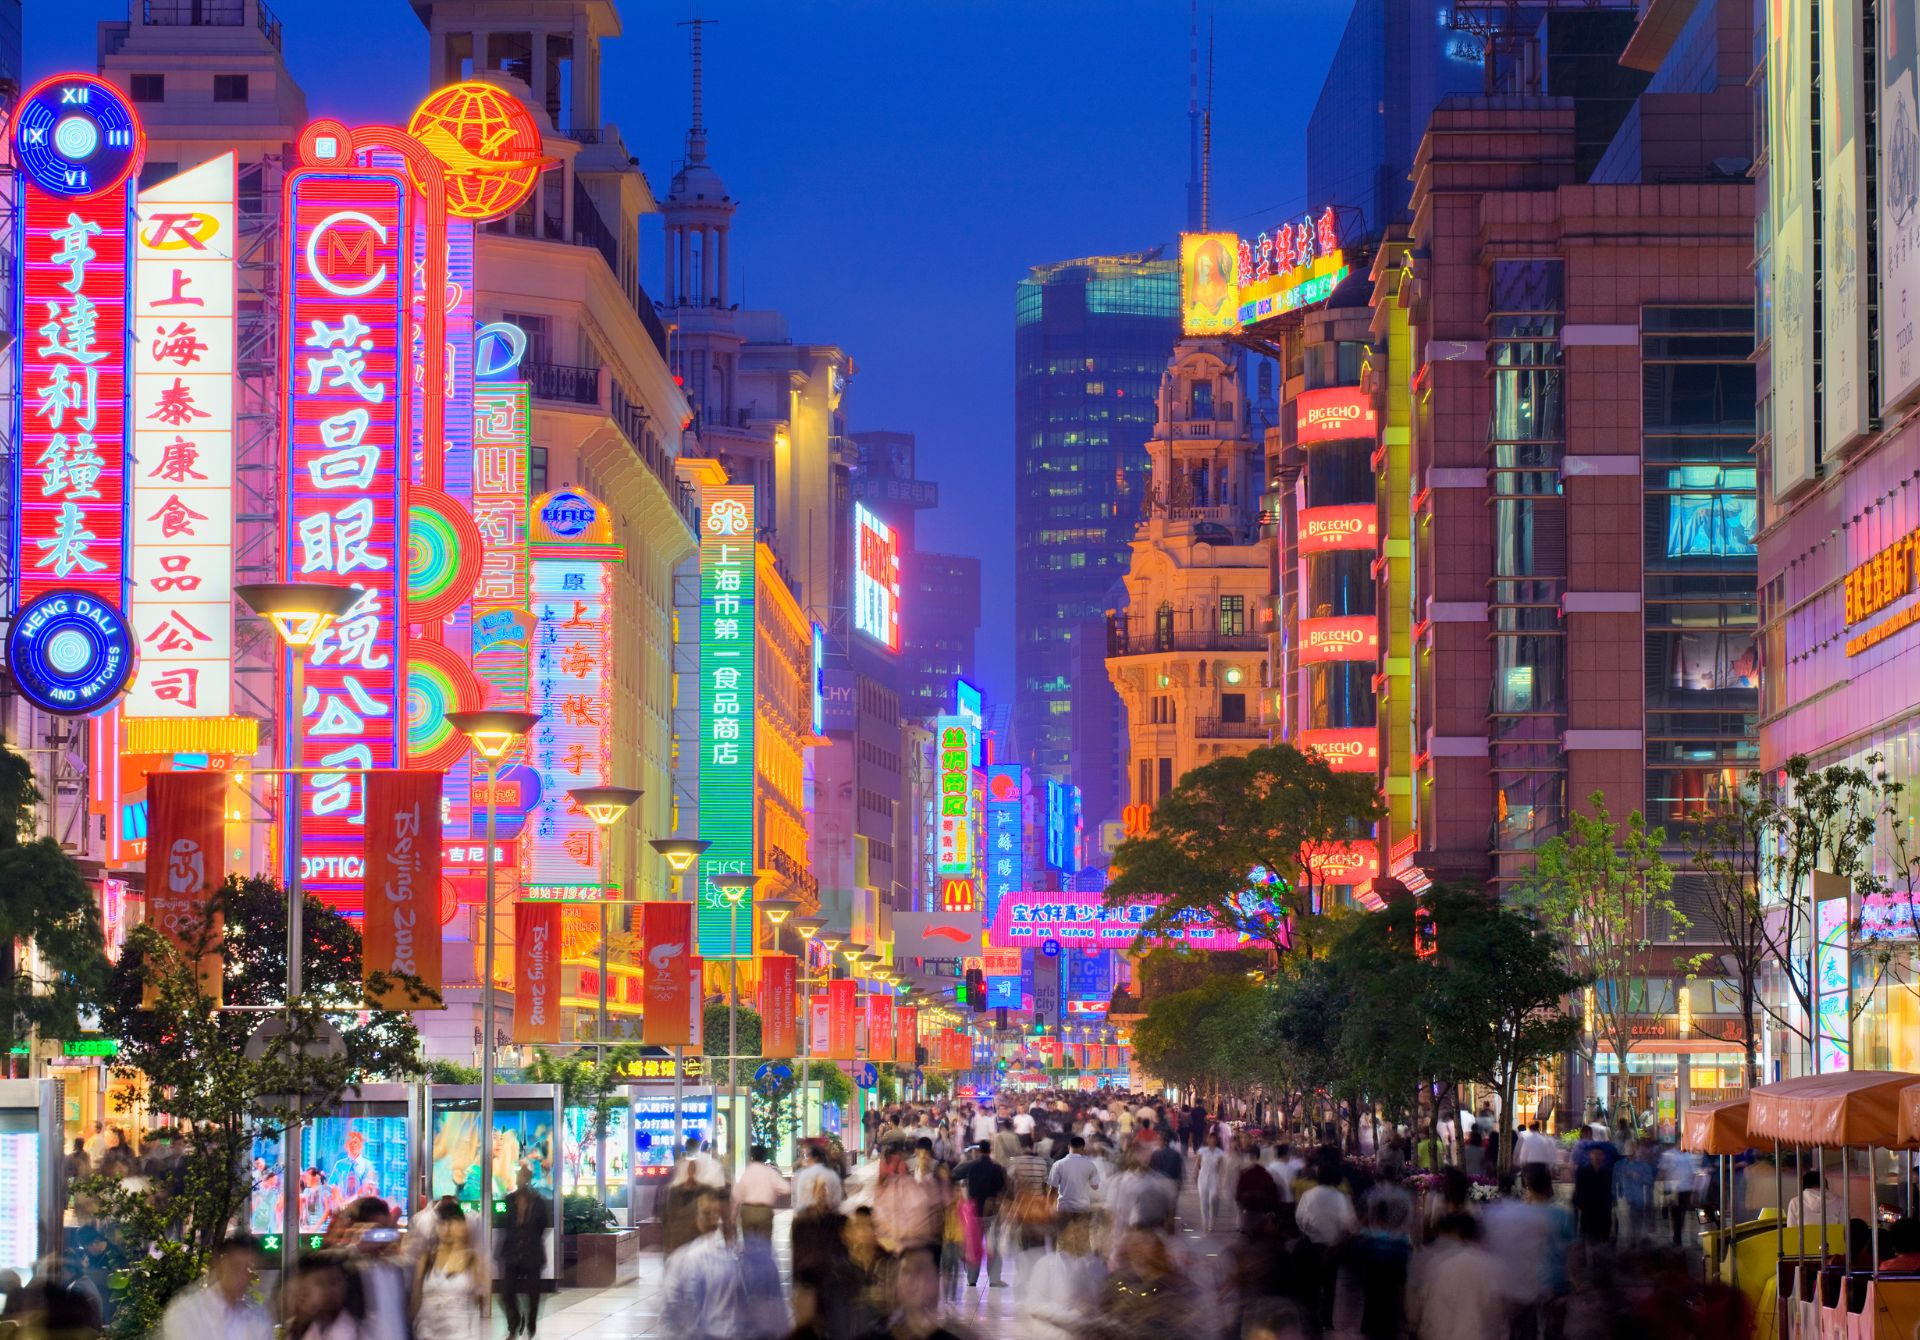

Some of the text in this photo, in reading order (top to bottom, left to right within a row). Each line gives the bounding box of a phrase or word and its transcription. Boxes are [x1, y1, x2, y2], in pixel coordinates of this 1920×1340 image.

[1308, 408, 1325, 424] BIG
[1326, 404, 1361, 419] ECHO
[144, 268, 214, 709] 上海泰康食品公司
[1308, 518, 1363, 536] BIG ECHO
[21, 599, 118, 638] HENG DALI
[1310, 629, 1364, 645] BIG ECHO
[49, 688, 76, 701] AND
[80, 646, 120, 698] WATCHES
[712, 543, 742, 766] 上海市第一食品商店
[1329, 741, 1363, 755] ECHO
[385, 800, 420, 902] Beijing
[705, 891, 746, 909] Stoe
[391, 906, 418, 976] 2008
[528, 920, 549, 980] Beijing
[1010, 927, 1032, 937] BAO
[1060, 928, 1094, 938] XIANG
[1102, 928, 1157, 939] SHOPPNG
[531, 985, 546, 1027] 2008
[1631, 1026, 1665, 1035] ELATO
